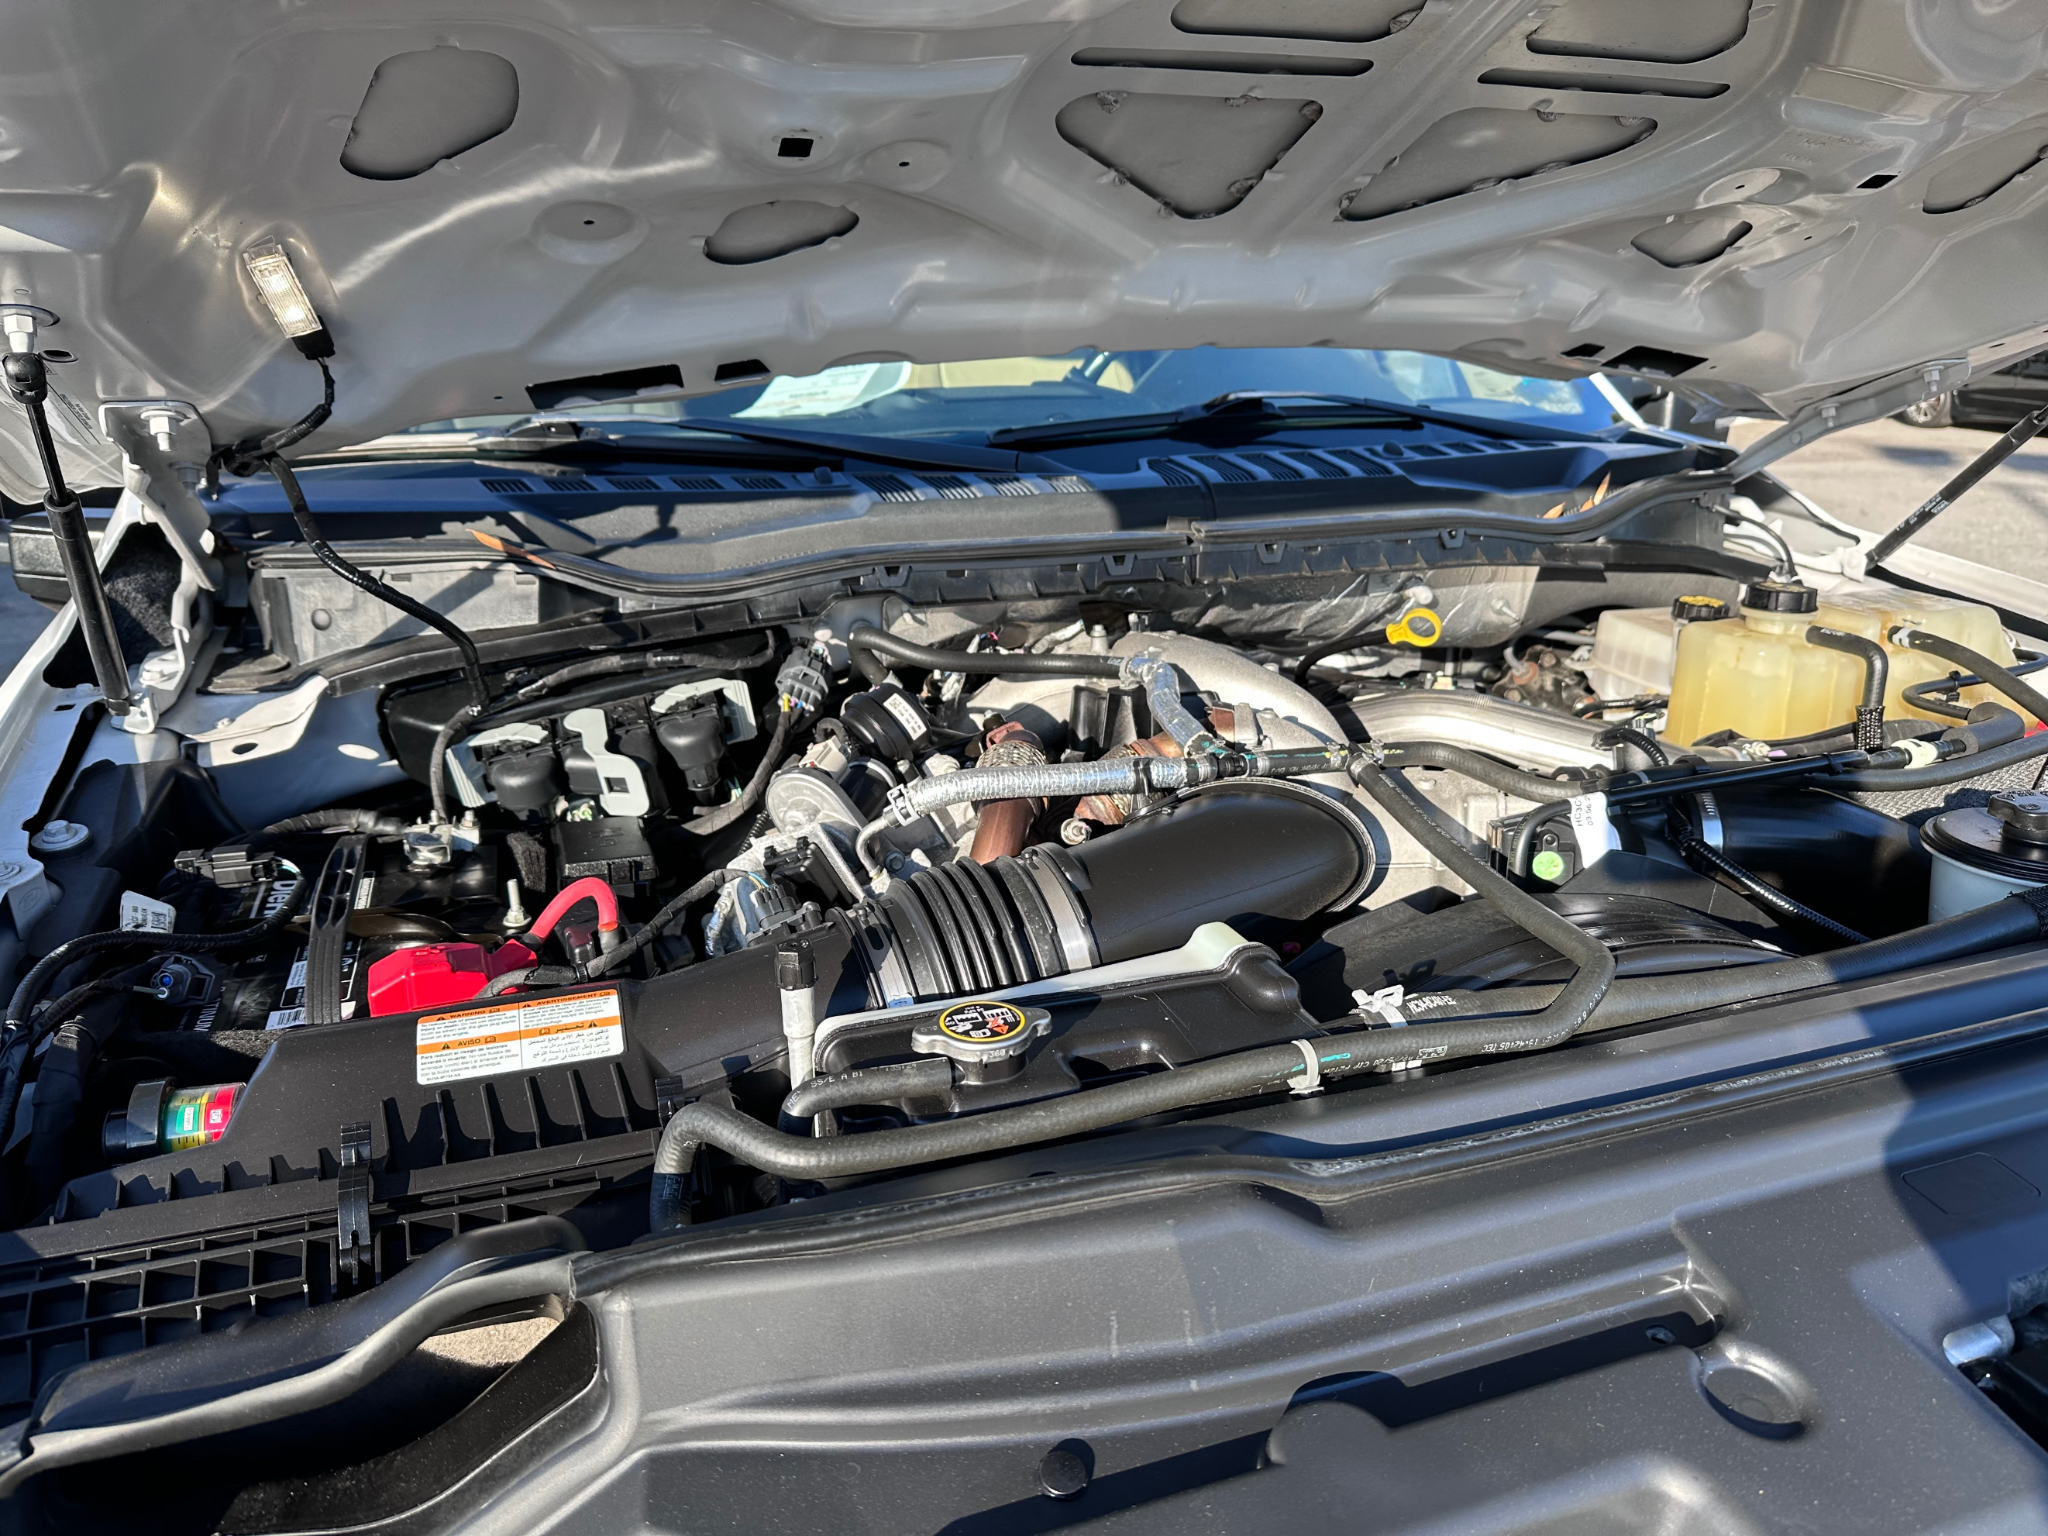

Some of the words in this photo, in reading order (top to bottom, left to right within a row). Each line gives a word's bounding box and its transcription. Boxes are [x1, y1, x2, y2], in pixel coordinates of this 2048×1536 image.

[1574, 798, 1584, 826] HC3C
[537, 993, 598, 1005] AVERTISSEMENT
[450, 1010, 486, 1019] WARNING
[458, 1038, 480, 1047] AVISO
